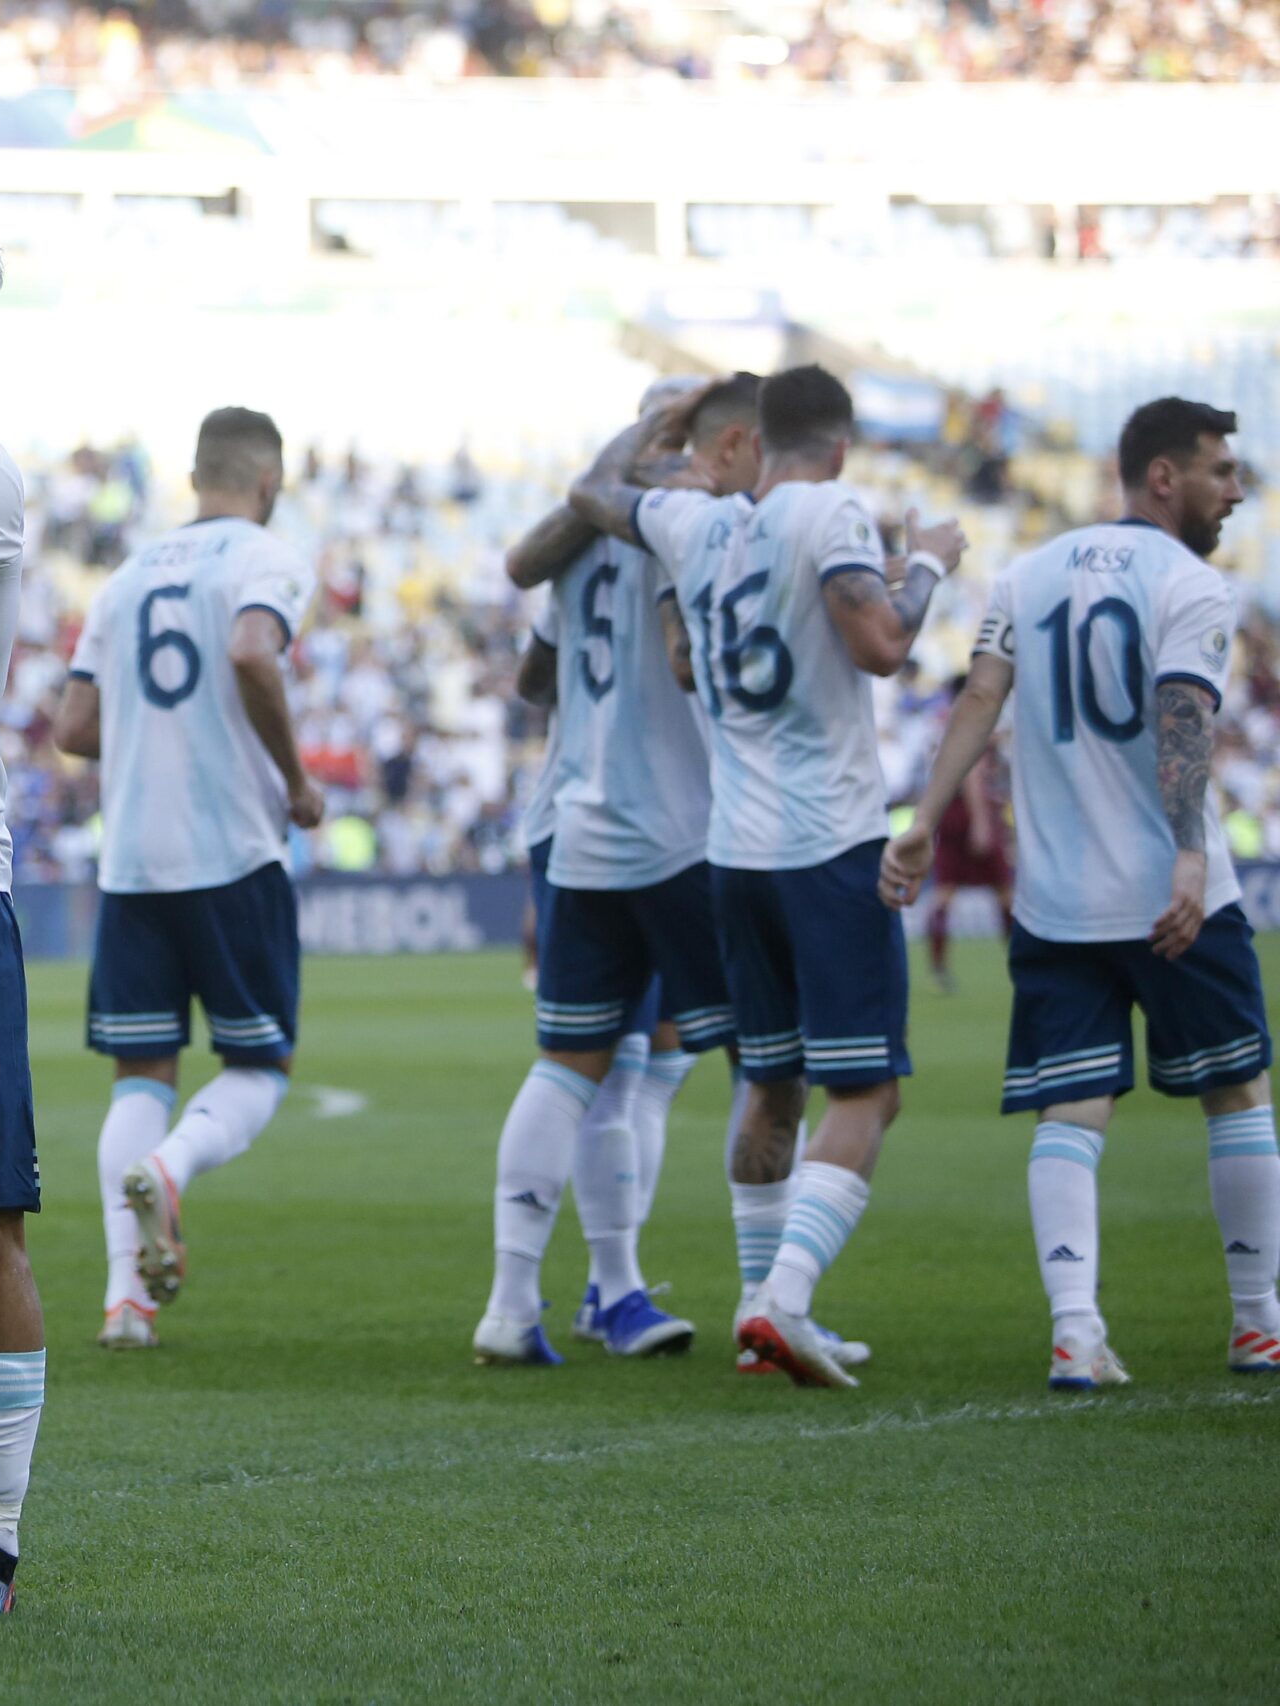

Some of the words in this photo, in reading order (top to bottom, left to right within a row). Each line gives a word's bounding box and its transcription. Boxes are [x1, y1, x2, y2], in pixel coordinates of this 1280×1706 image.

[1066, 546, 1134, 574] MESSI
[138, 582, 202, 710] 6
[691, 567, 793, 718] 16
[1036, 597, 1144, 744] 10
